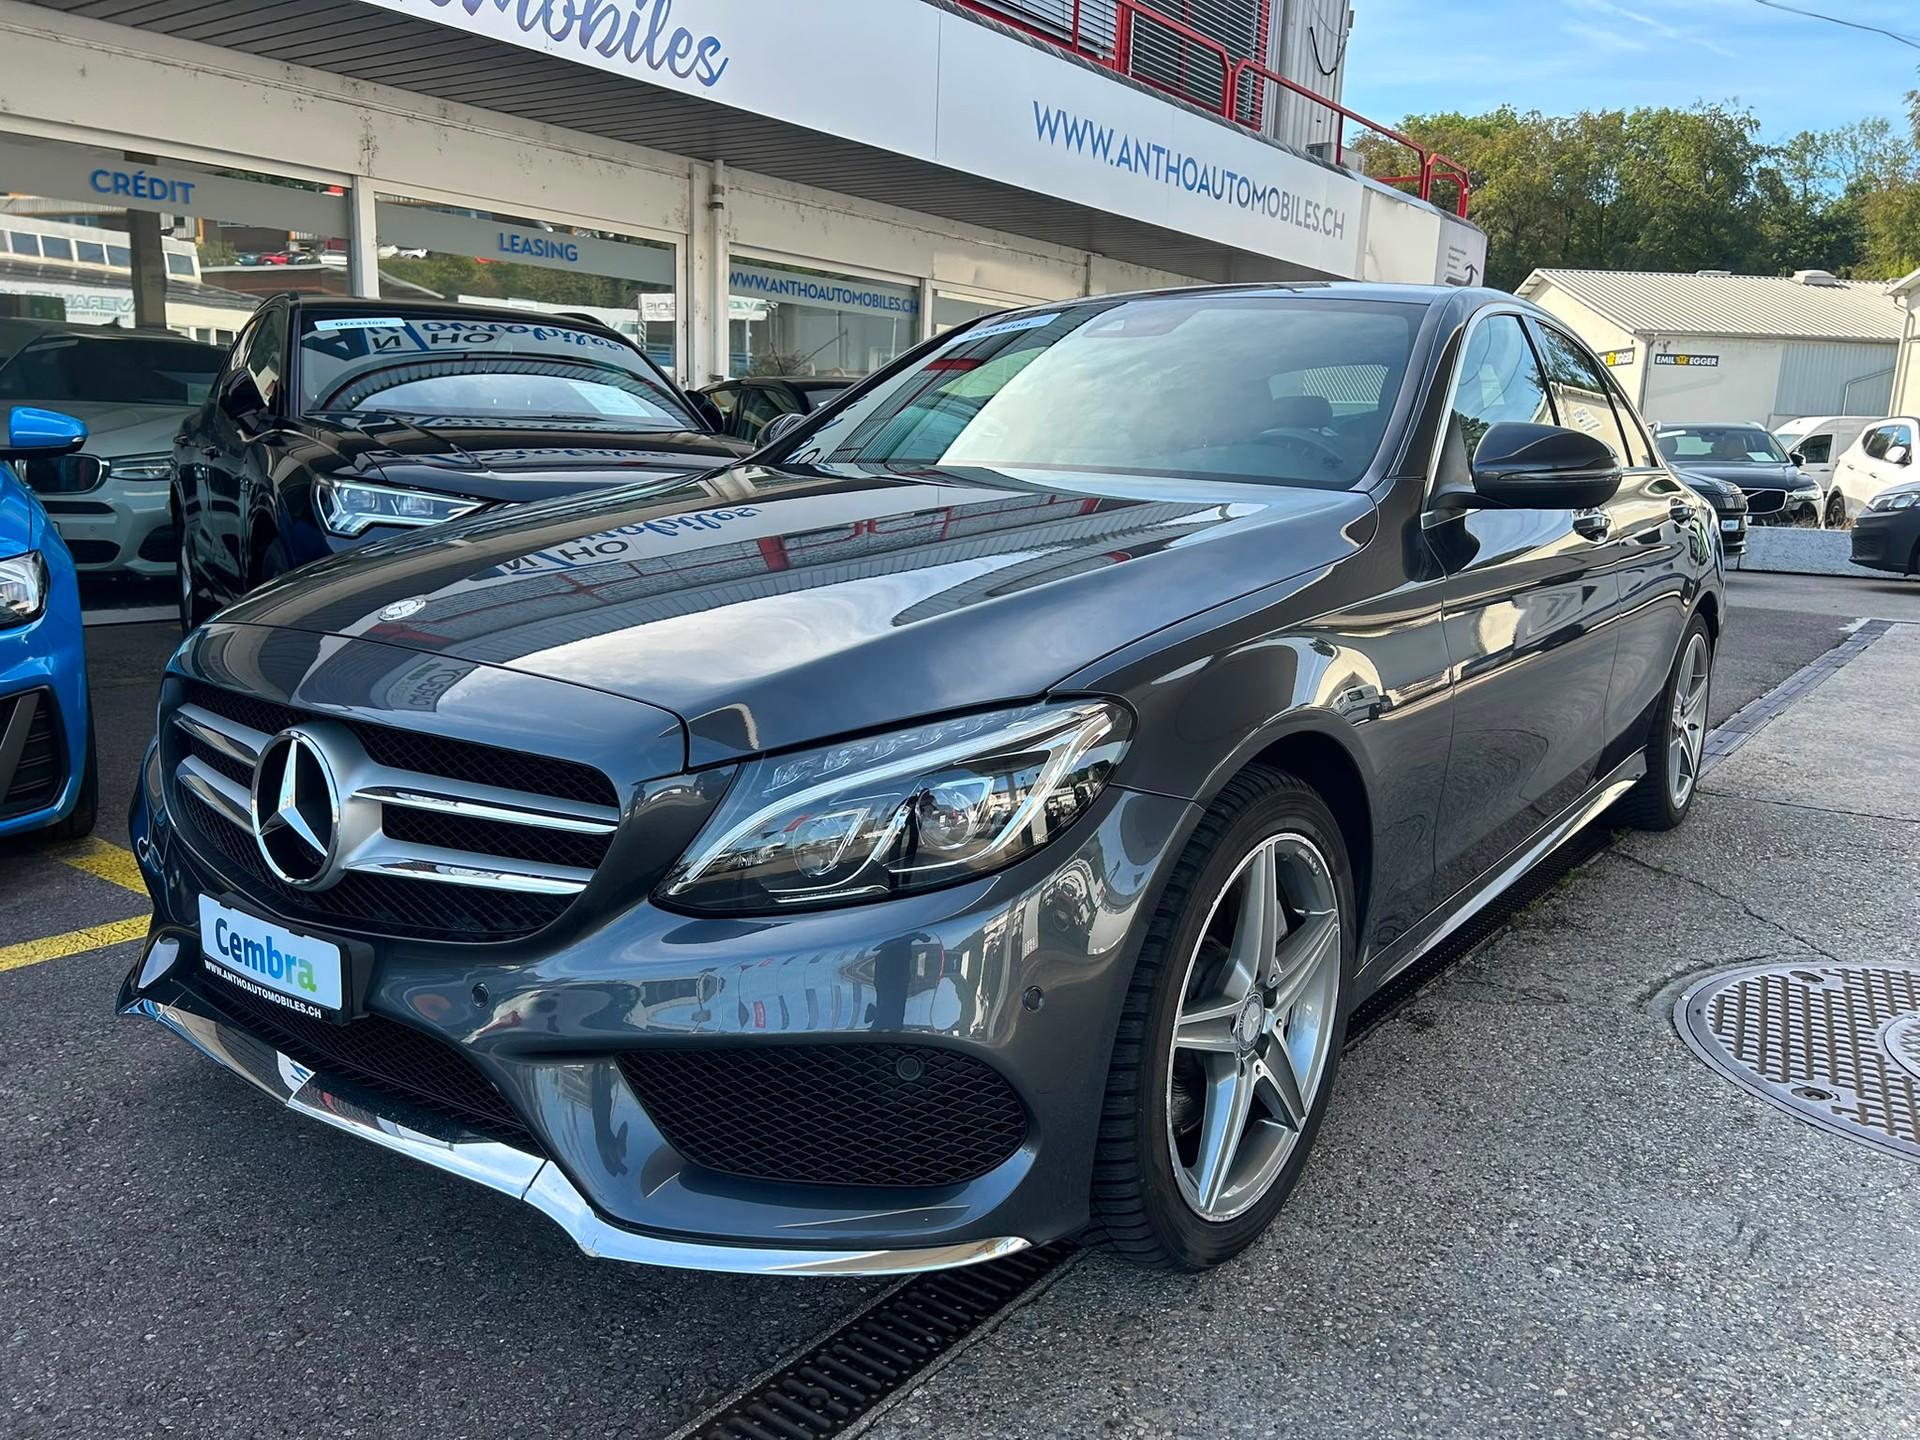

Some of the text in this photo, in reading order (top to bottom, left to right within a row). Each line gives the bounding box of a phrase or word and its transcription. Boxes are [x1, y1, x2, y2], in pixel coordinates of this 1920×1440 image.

[90, 169, 196, 205] CRÉDIT
[1033, 100, 1345, 240] WWW.ANTHOAUTOMOBILES.CH
[498, 232, 579, 262] LEASING
[729, 271, 919, 314] WWW.ANTHOAUTOMOBILES.CH
[968, 321, 1031, 339] Occasion
[1656, 355, 1717, 366] EMIL EGGER
[214, 917, 318, 993] Cembra
[204, 959, 322, 1019] WWW.ANTHOAUTOMOBILES.CH
